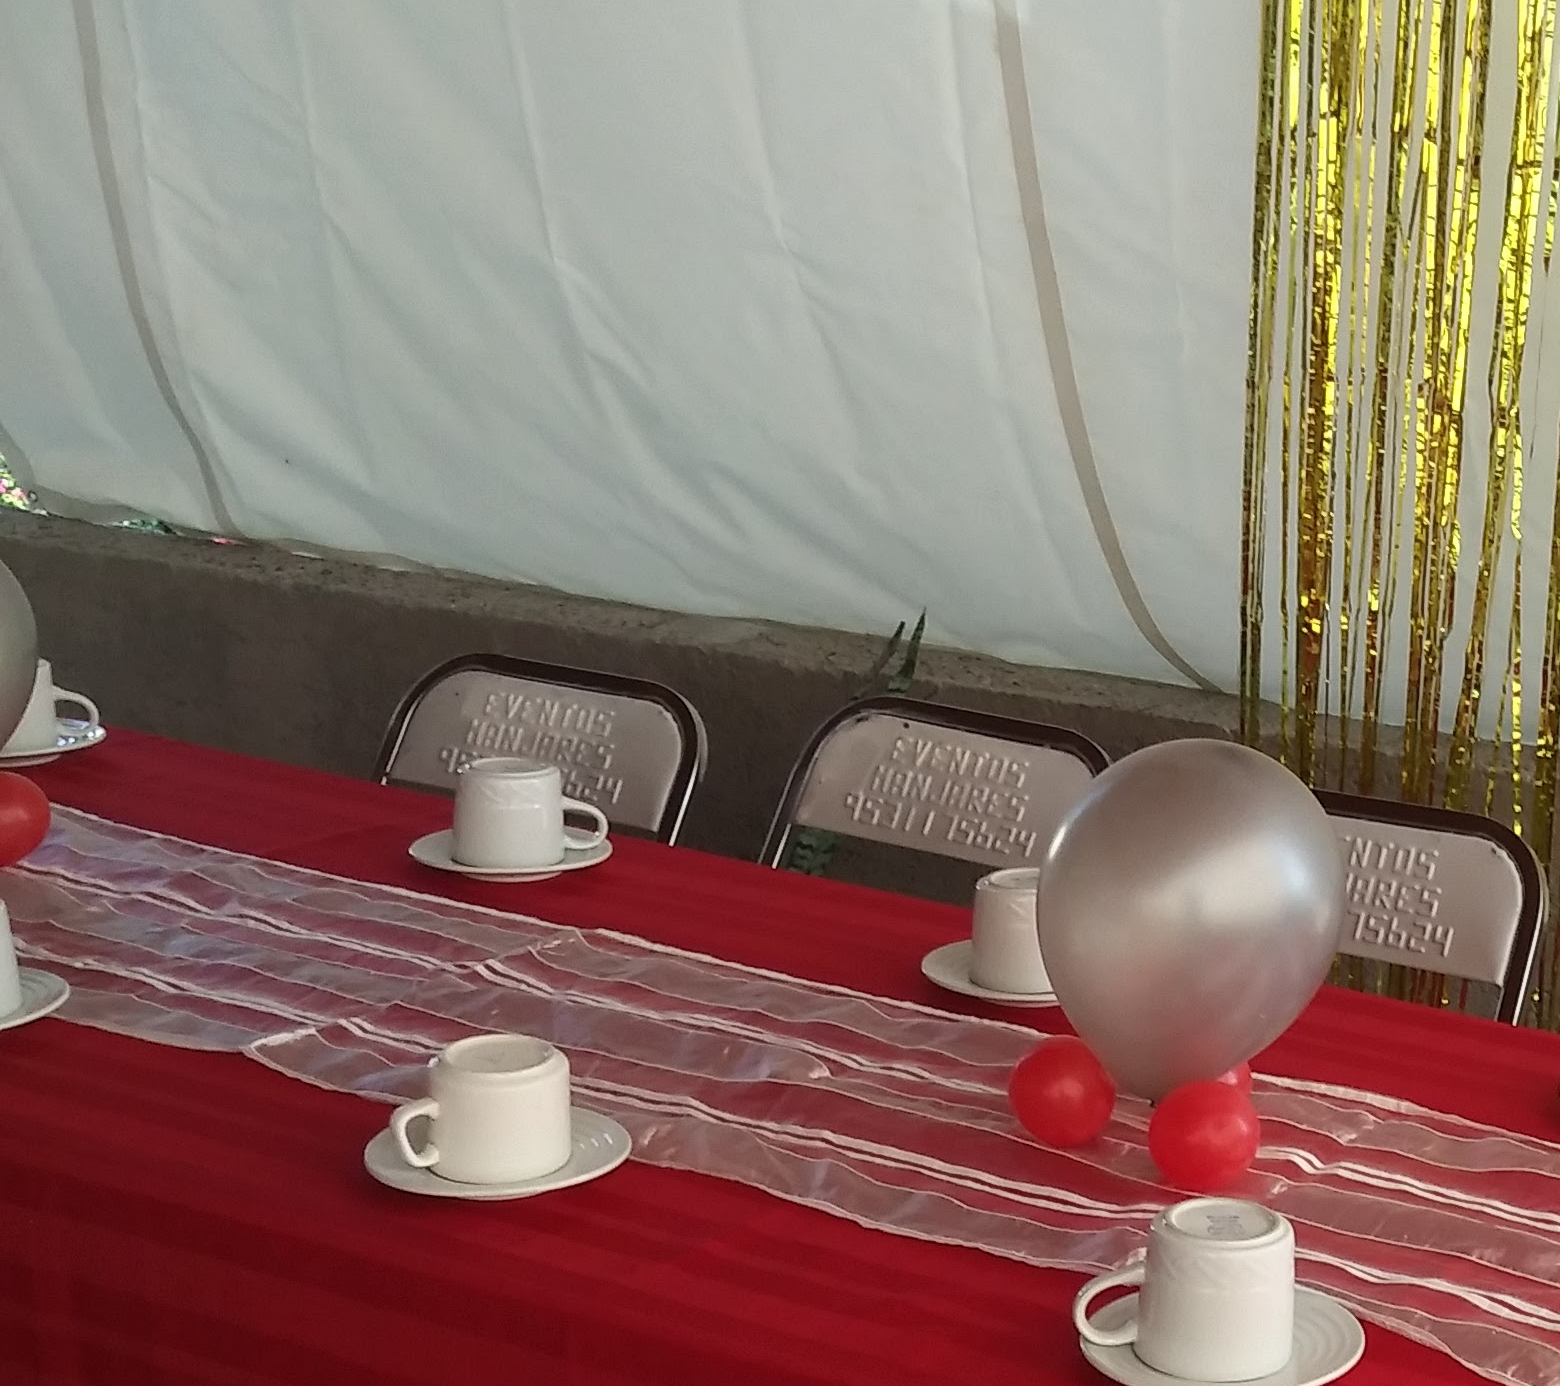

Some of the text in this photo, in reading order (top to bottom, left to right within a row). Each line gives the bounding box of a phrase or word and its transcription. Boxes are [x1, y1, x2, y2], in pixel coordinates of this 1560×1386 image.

[484, 691, 616, 737] EVENTOS
[891, 735, 1029, 788] EVENTOS
[871, 764, 1029, 822] MANJARES
[1344, 835, 1440, 881] NTOS
[1347, 910, 1455, 958] 75624
